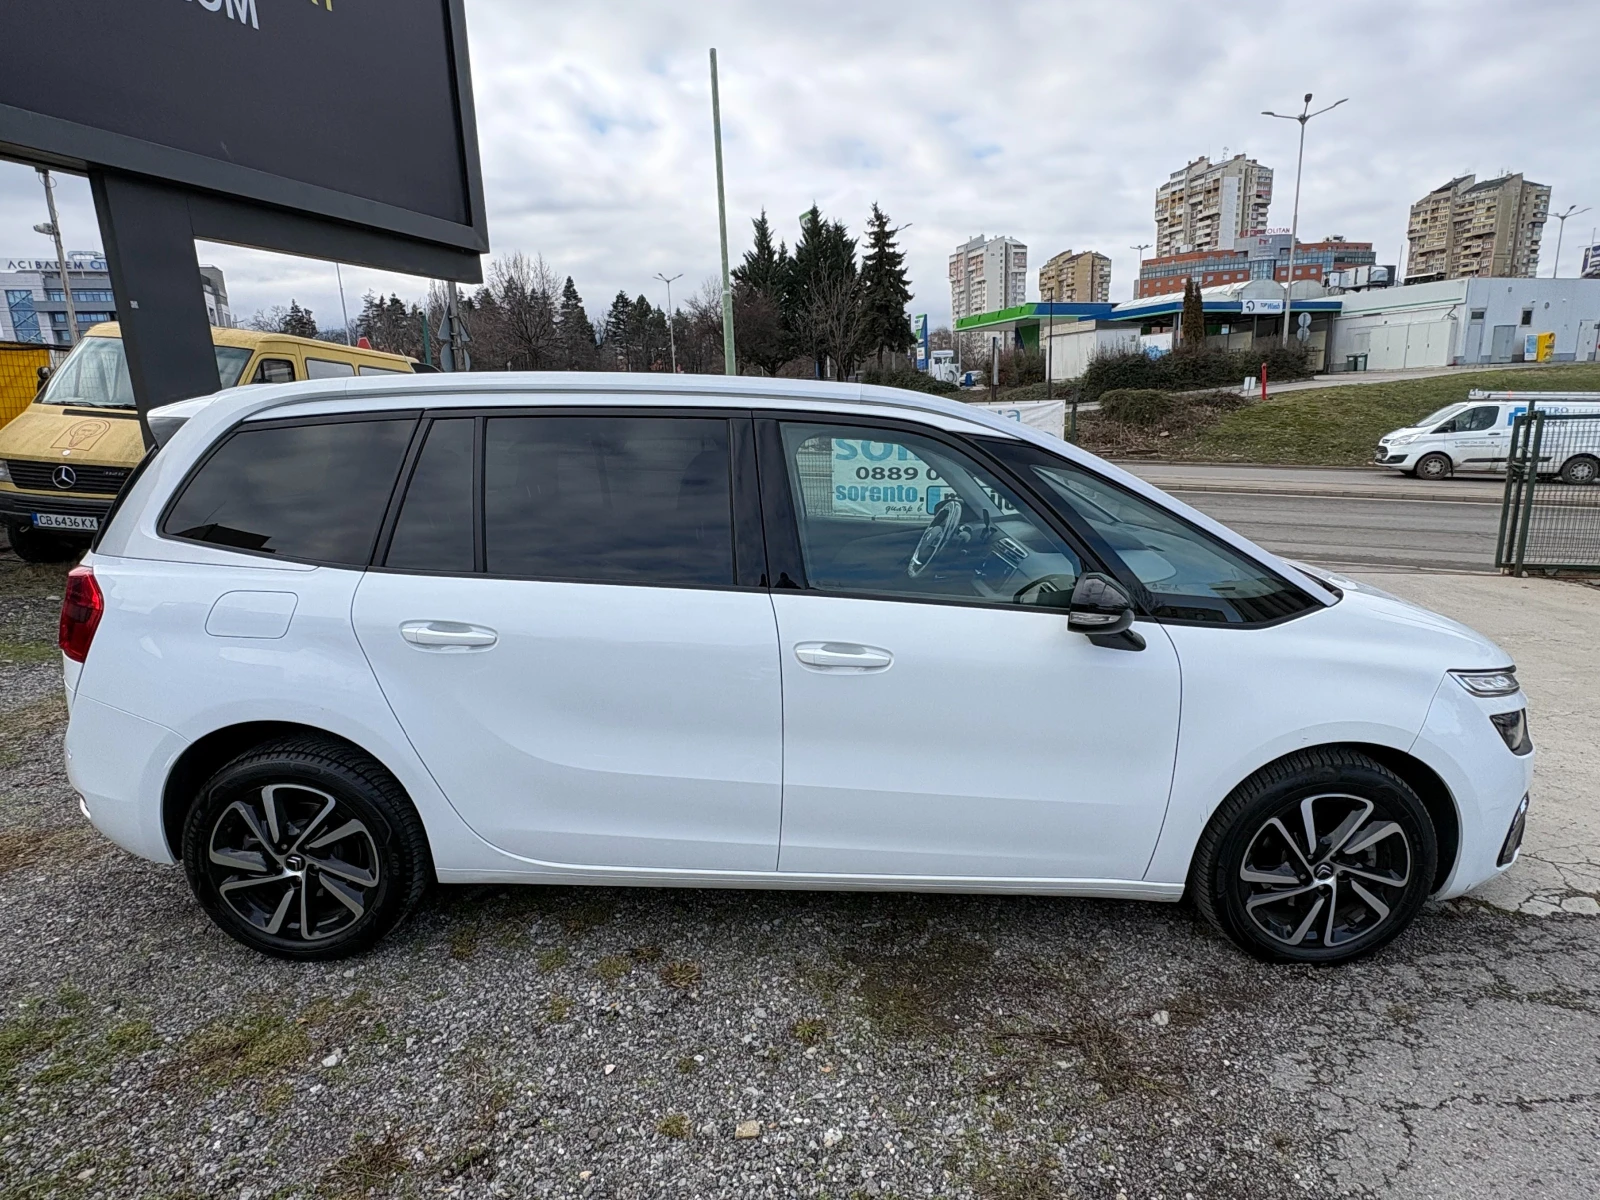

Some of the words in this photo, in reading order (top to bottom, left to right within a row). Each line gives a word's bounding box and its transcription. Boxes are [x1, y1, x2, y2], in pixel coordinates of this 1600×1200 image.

[856, 466, 919, 481] 0889
[926, 467, 940, 480] 0
[54, 516, 80, 528] 6436
